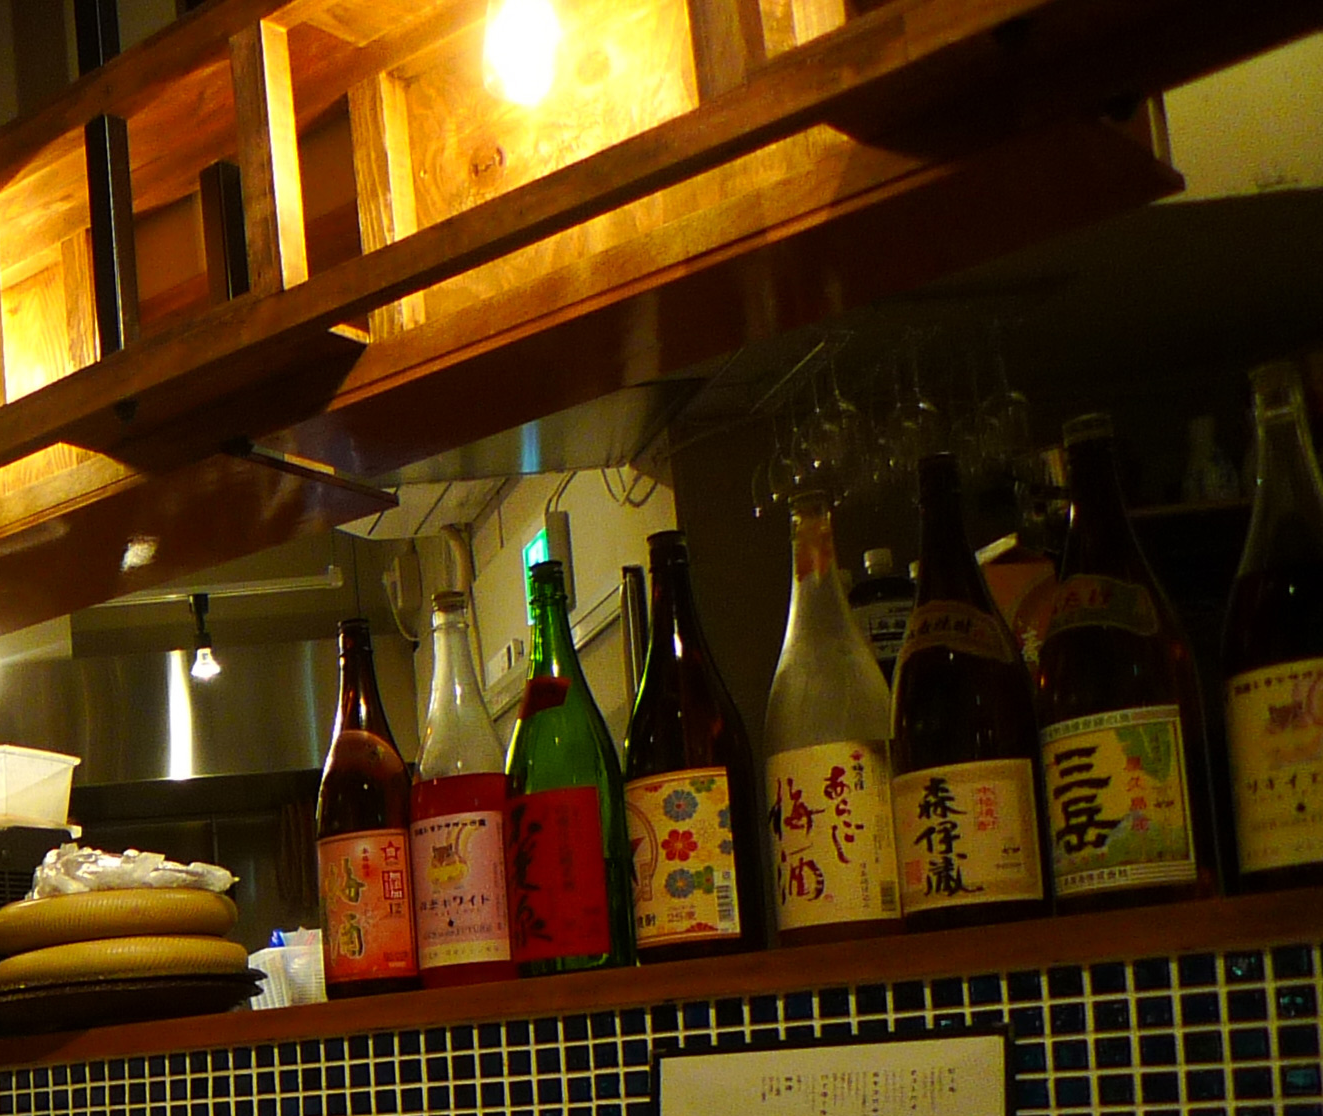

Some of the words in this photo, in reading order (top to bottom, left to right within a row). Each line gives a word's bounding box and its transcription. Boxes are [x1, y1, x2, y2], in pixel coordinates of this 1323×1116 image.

[768, 777, 826, 905] 梅酒
[913, 777, 984, 896] 森伊蔵
[1053, 747, 1122, 854] 三岳
[325, 857, 367, 966] 梅酒
